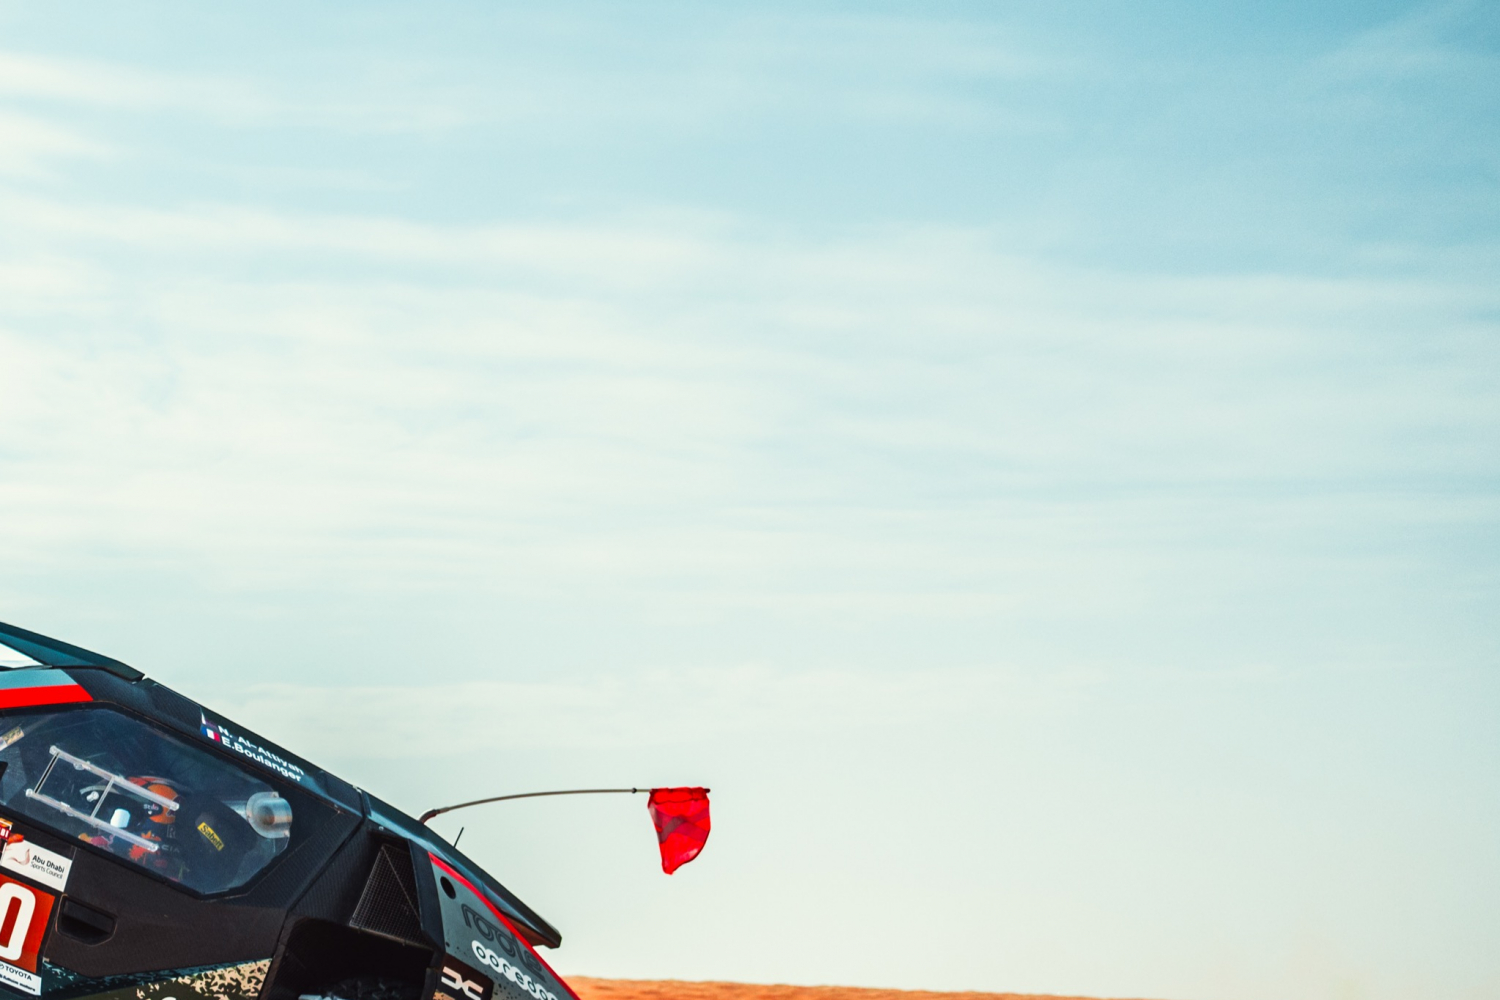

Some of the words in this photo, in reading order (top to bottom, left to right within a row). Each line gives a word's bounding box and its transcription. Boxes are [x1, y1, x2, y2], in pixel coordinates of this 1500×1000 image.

[221, 735, 302, 782] E.Boulanger
[200, 824, 224, 850] Sabelt
[30, 861, 46, 875] Sports
[46, 868, 63, 880] Council
[32, 854, 47, 867] Abu
[47, 860, 65, 874] Dhabi
[5, 965, 32, 982] TOYOTA
